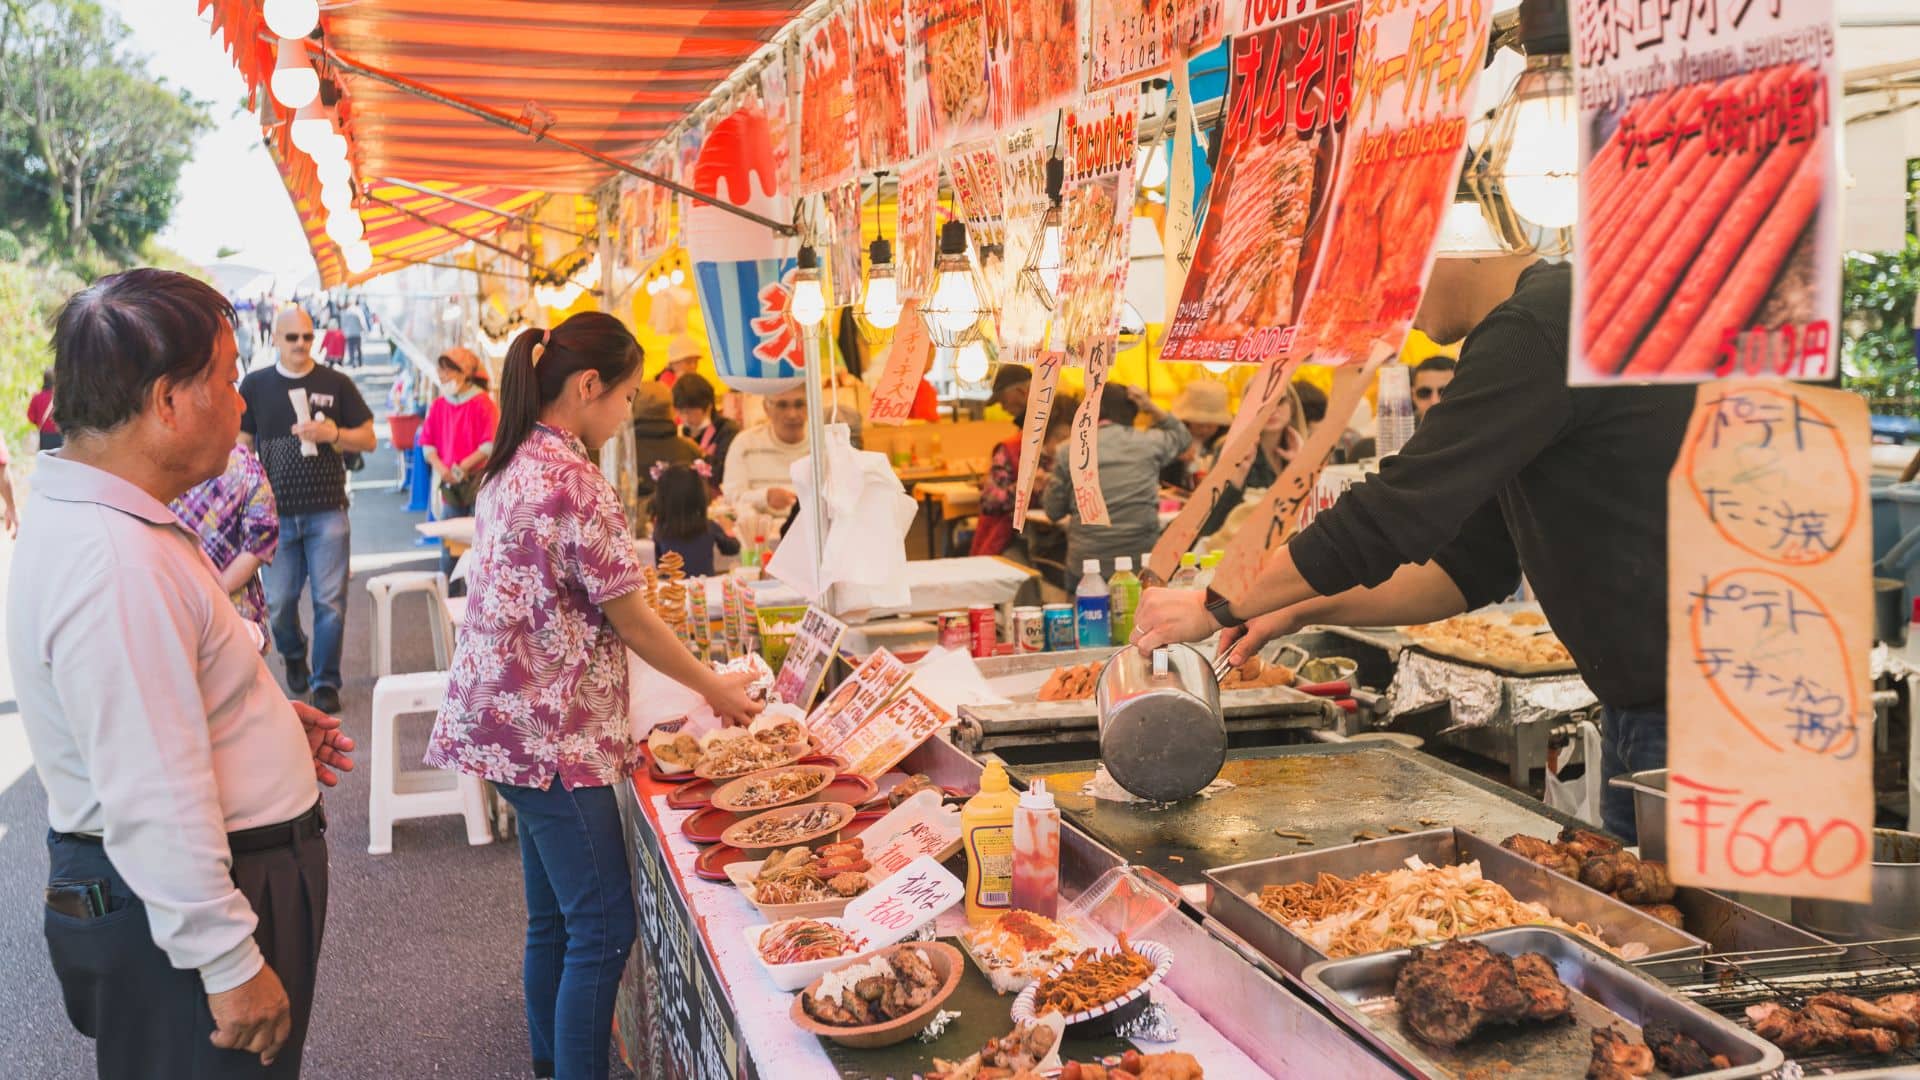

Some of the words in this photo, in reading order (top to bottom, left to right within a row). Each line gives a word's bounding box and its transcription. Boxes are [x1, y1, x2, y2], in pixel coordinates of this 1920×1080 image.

[1226, 6, 1360, 146] オムそば
[1350, 0, 1488, 122] ジャークチキン
[1743, 22, 1833, 72] sausage
[1354, 121, 1391, 166] Jerk
[1394, 111, 1466, 158] chicken
[1714, 319, 1830, 377] 500円
[1705, 393, 1838, 451] ポテト
[1688, 575, 1829, 635] ポテト
[865, 895, 914, 930] ¥600
